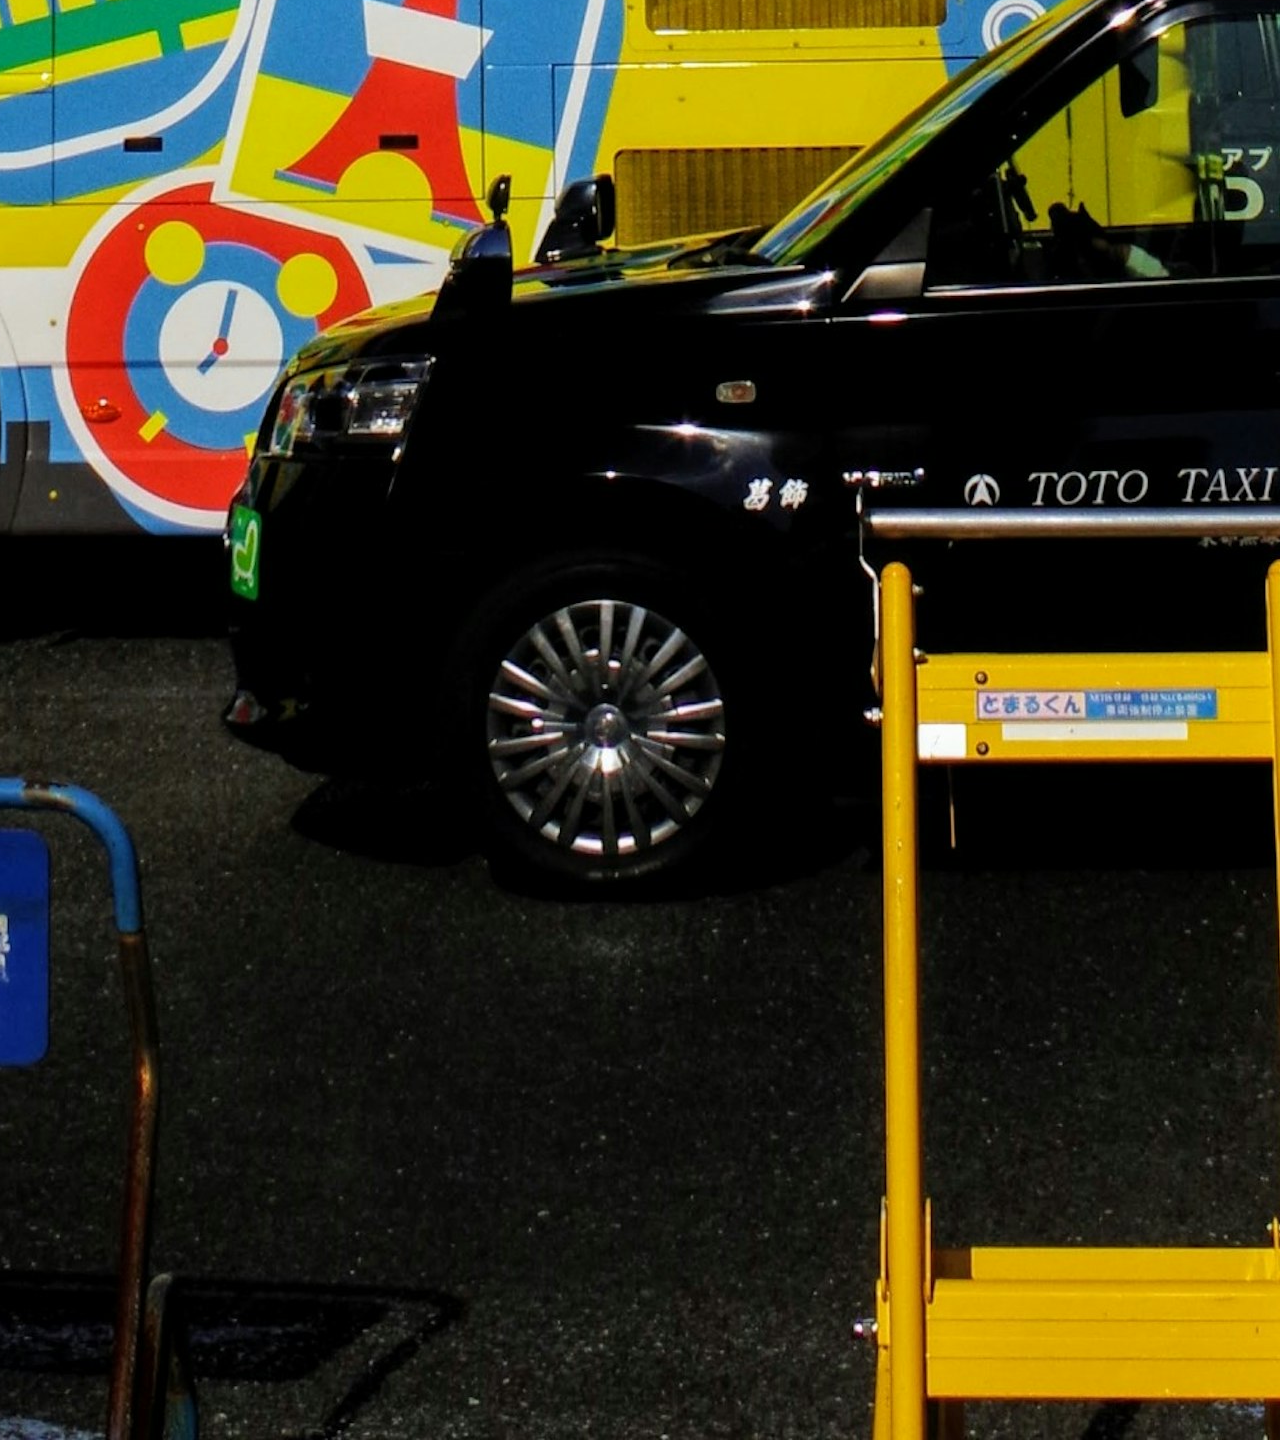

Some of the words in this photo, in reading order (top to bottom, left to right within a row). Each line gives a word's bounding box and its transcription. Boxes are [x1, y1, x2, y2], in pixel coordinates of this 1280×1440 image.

[1027, 470, 1149, 508] TOTO
[1177, 467, 1279, 504] TAXI
[982, 694, 1082, 715] とまるくん
